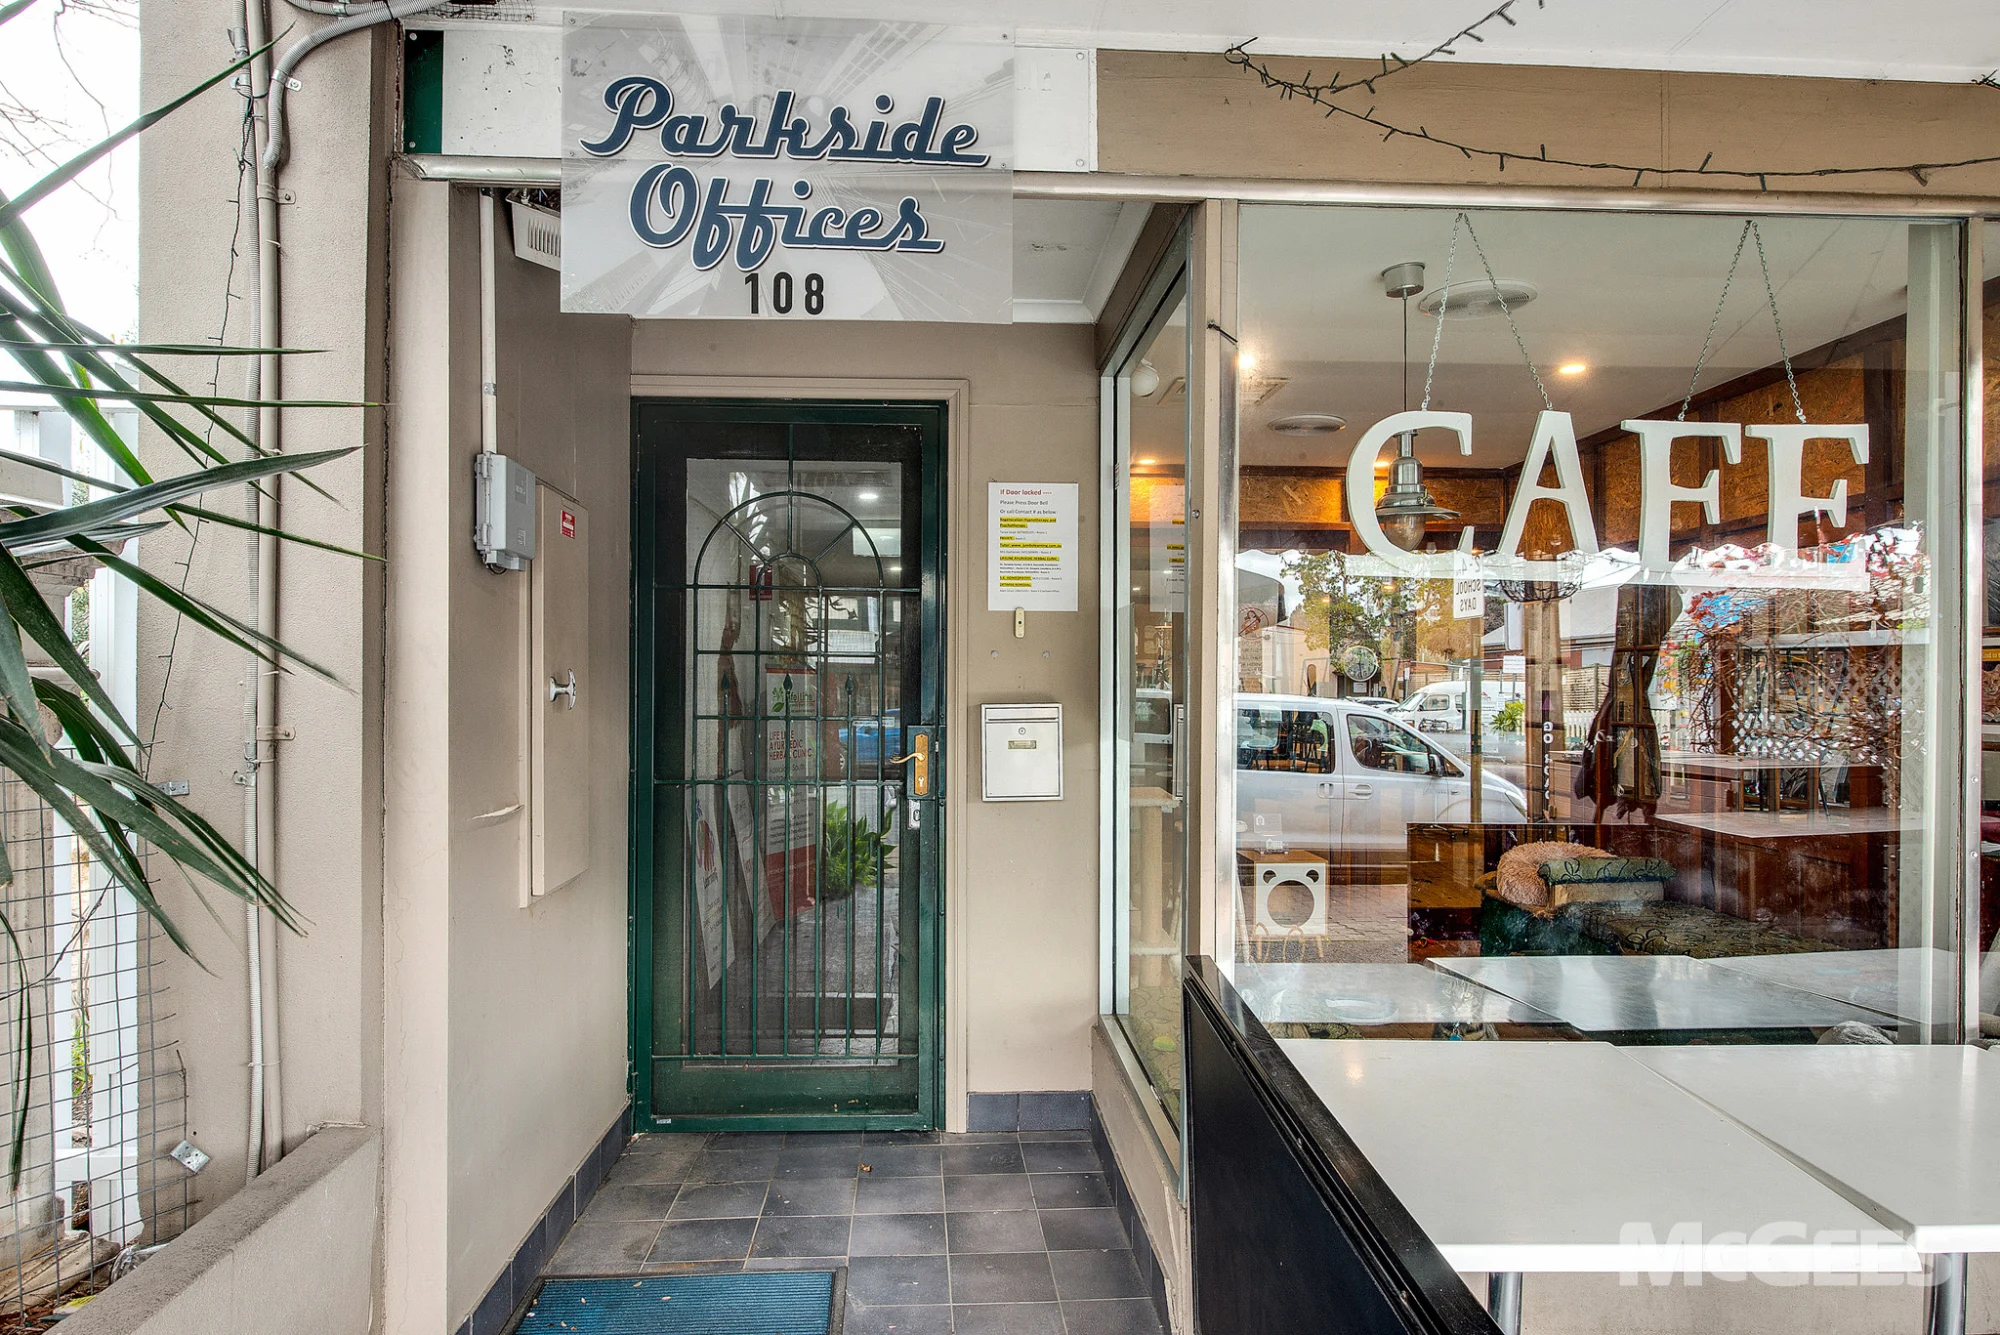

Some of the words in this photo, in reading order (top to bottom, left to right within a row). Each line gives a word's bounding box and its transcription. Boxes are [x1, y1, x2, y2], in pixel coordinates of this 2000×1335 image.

[579, 74, 991, 167] Parkside
[628, 163, 945, 271] Offices
[744, 271, 825, 315] 108
[1346, 411, 1870, 586] CAFE
[769, 731, 780, 740] LIFE
[780, 730, 795, 740] LIE
[769, 739, 804, 750] AYUREDIC
